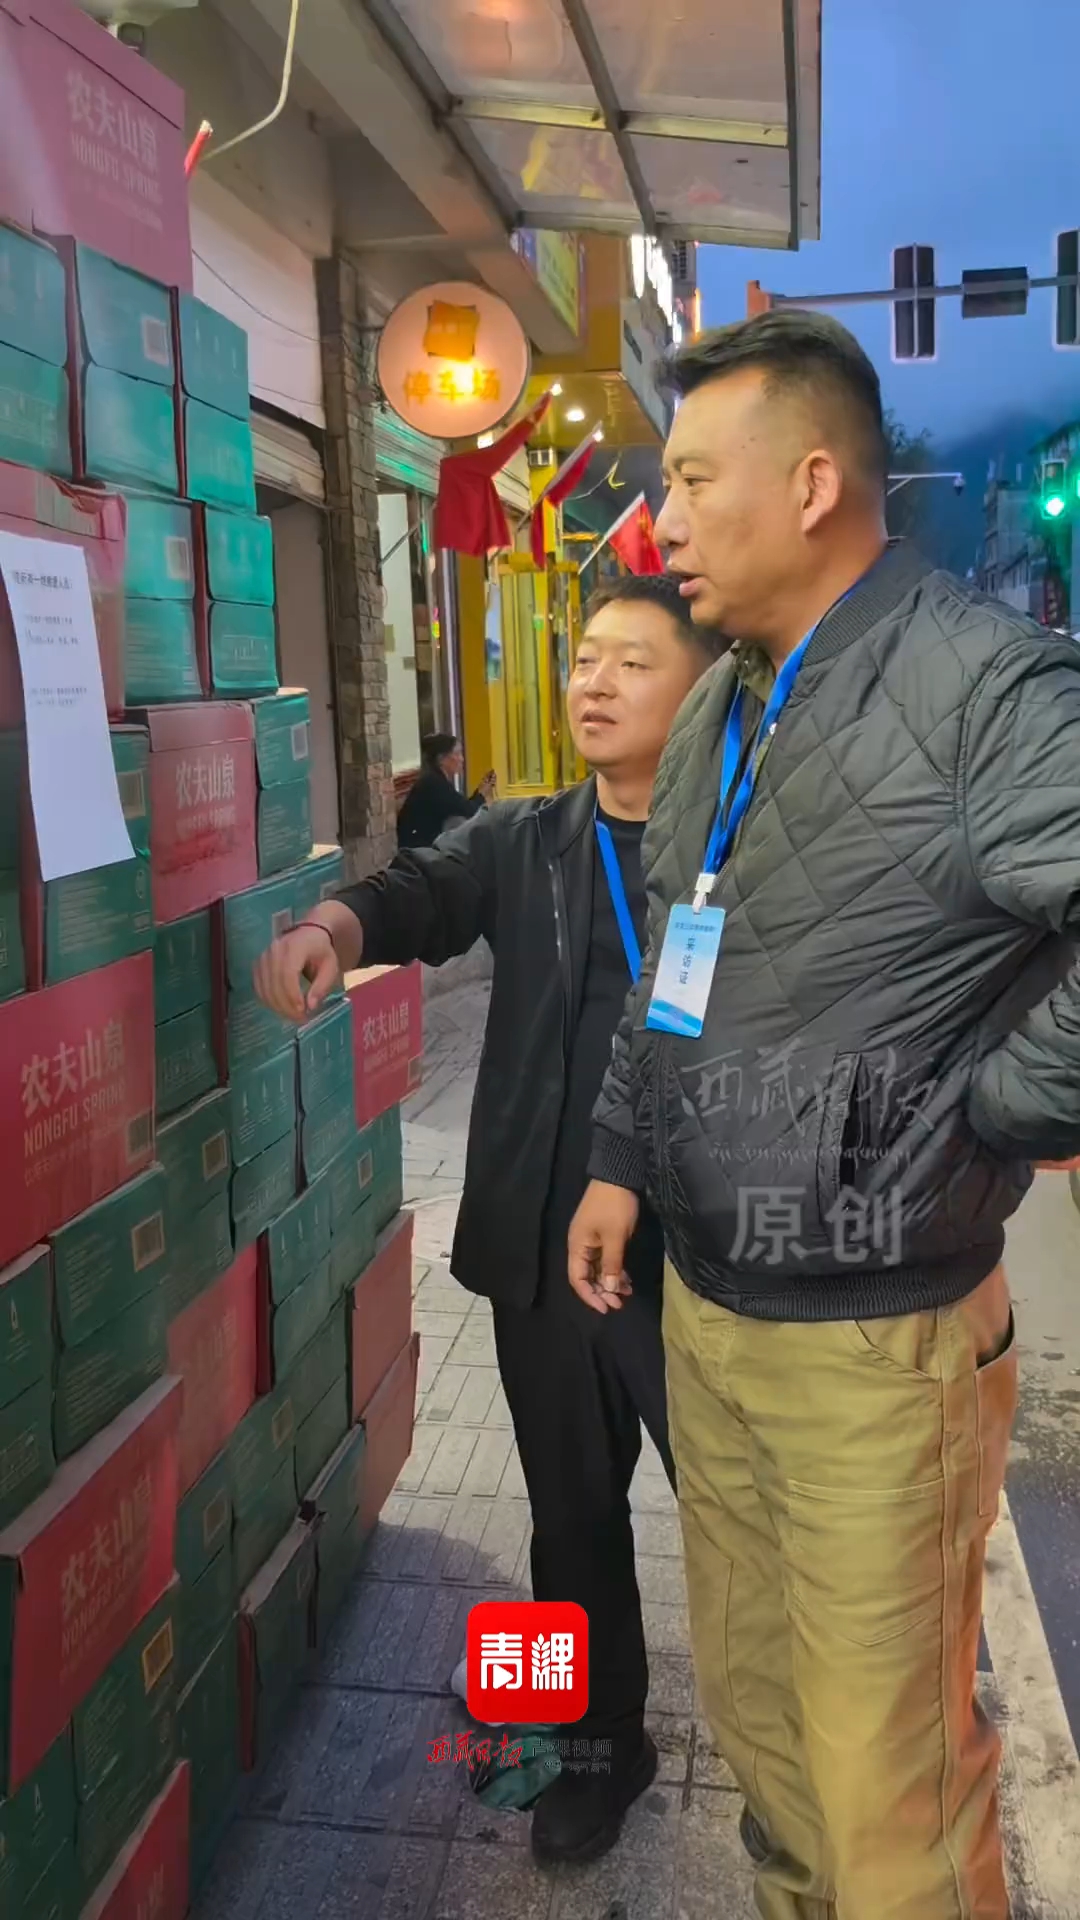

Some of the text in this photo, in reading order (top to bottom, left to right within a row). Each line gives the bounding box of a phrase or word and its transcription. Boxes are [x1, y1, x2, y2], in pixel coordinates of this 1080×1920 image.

[403, 367, 500, 407] 停车场
[175, 753, 234, 810] 农夫山泉
[362, 998, 409, 1052] 农夫山泉
[21, 1018, 125, 1118] 农夫山泉
[23, 1102, 78, 1158] NONGFU
